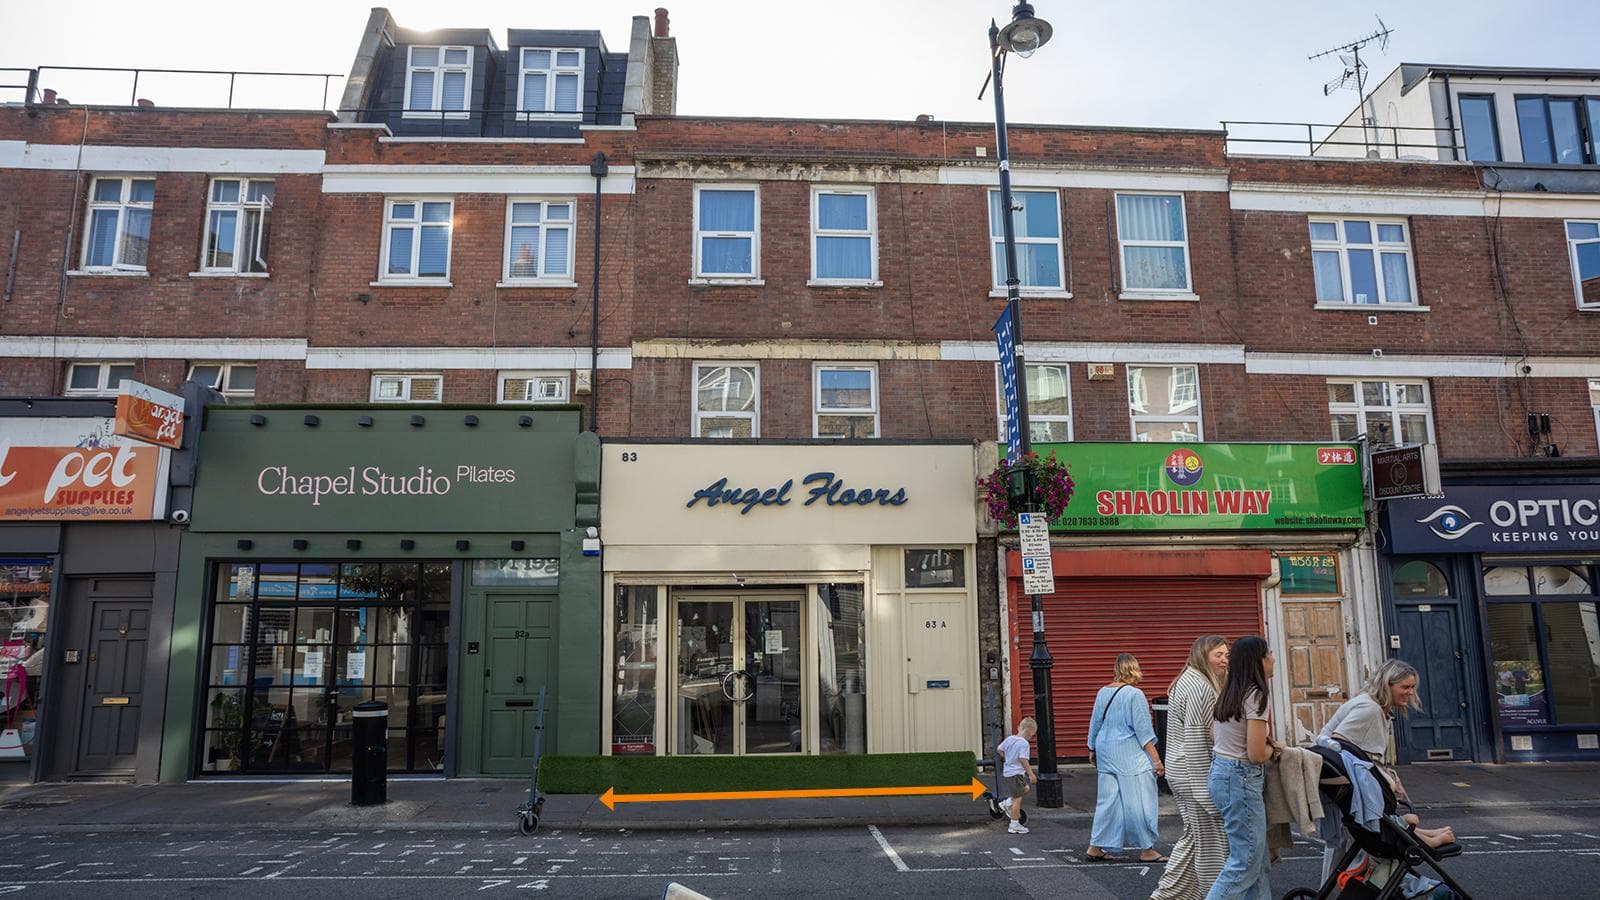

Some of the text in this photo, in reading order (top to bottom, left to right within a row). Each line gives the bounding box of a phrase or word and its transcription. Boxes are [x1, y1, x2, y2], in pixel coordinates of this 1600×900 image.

[622, 452, 637, 462] 83
[1402, 451, 1419, 461] ARTS
[44, 447, 136, 504] pet
[257, 465, 516, 506] Chapel Studio Pilates
[56, 490, 135, 505] SUPPLIES
[686, 472, 908, 515] Angel Floors
[1096, 490, 1271, 515] SHAOLIN WAY
[1489, 499, 1600, 527] OPTIC
[1492, 531, 1599, 542] KEEPING YOU
[925, 621, 937, 629] 83
